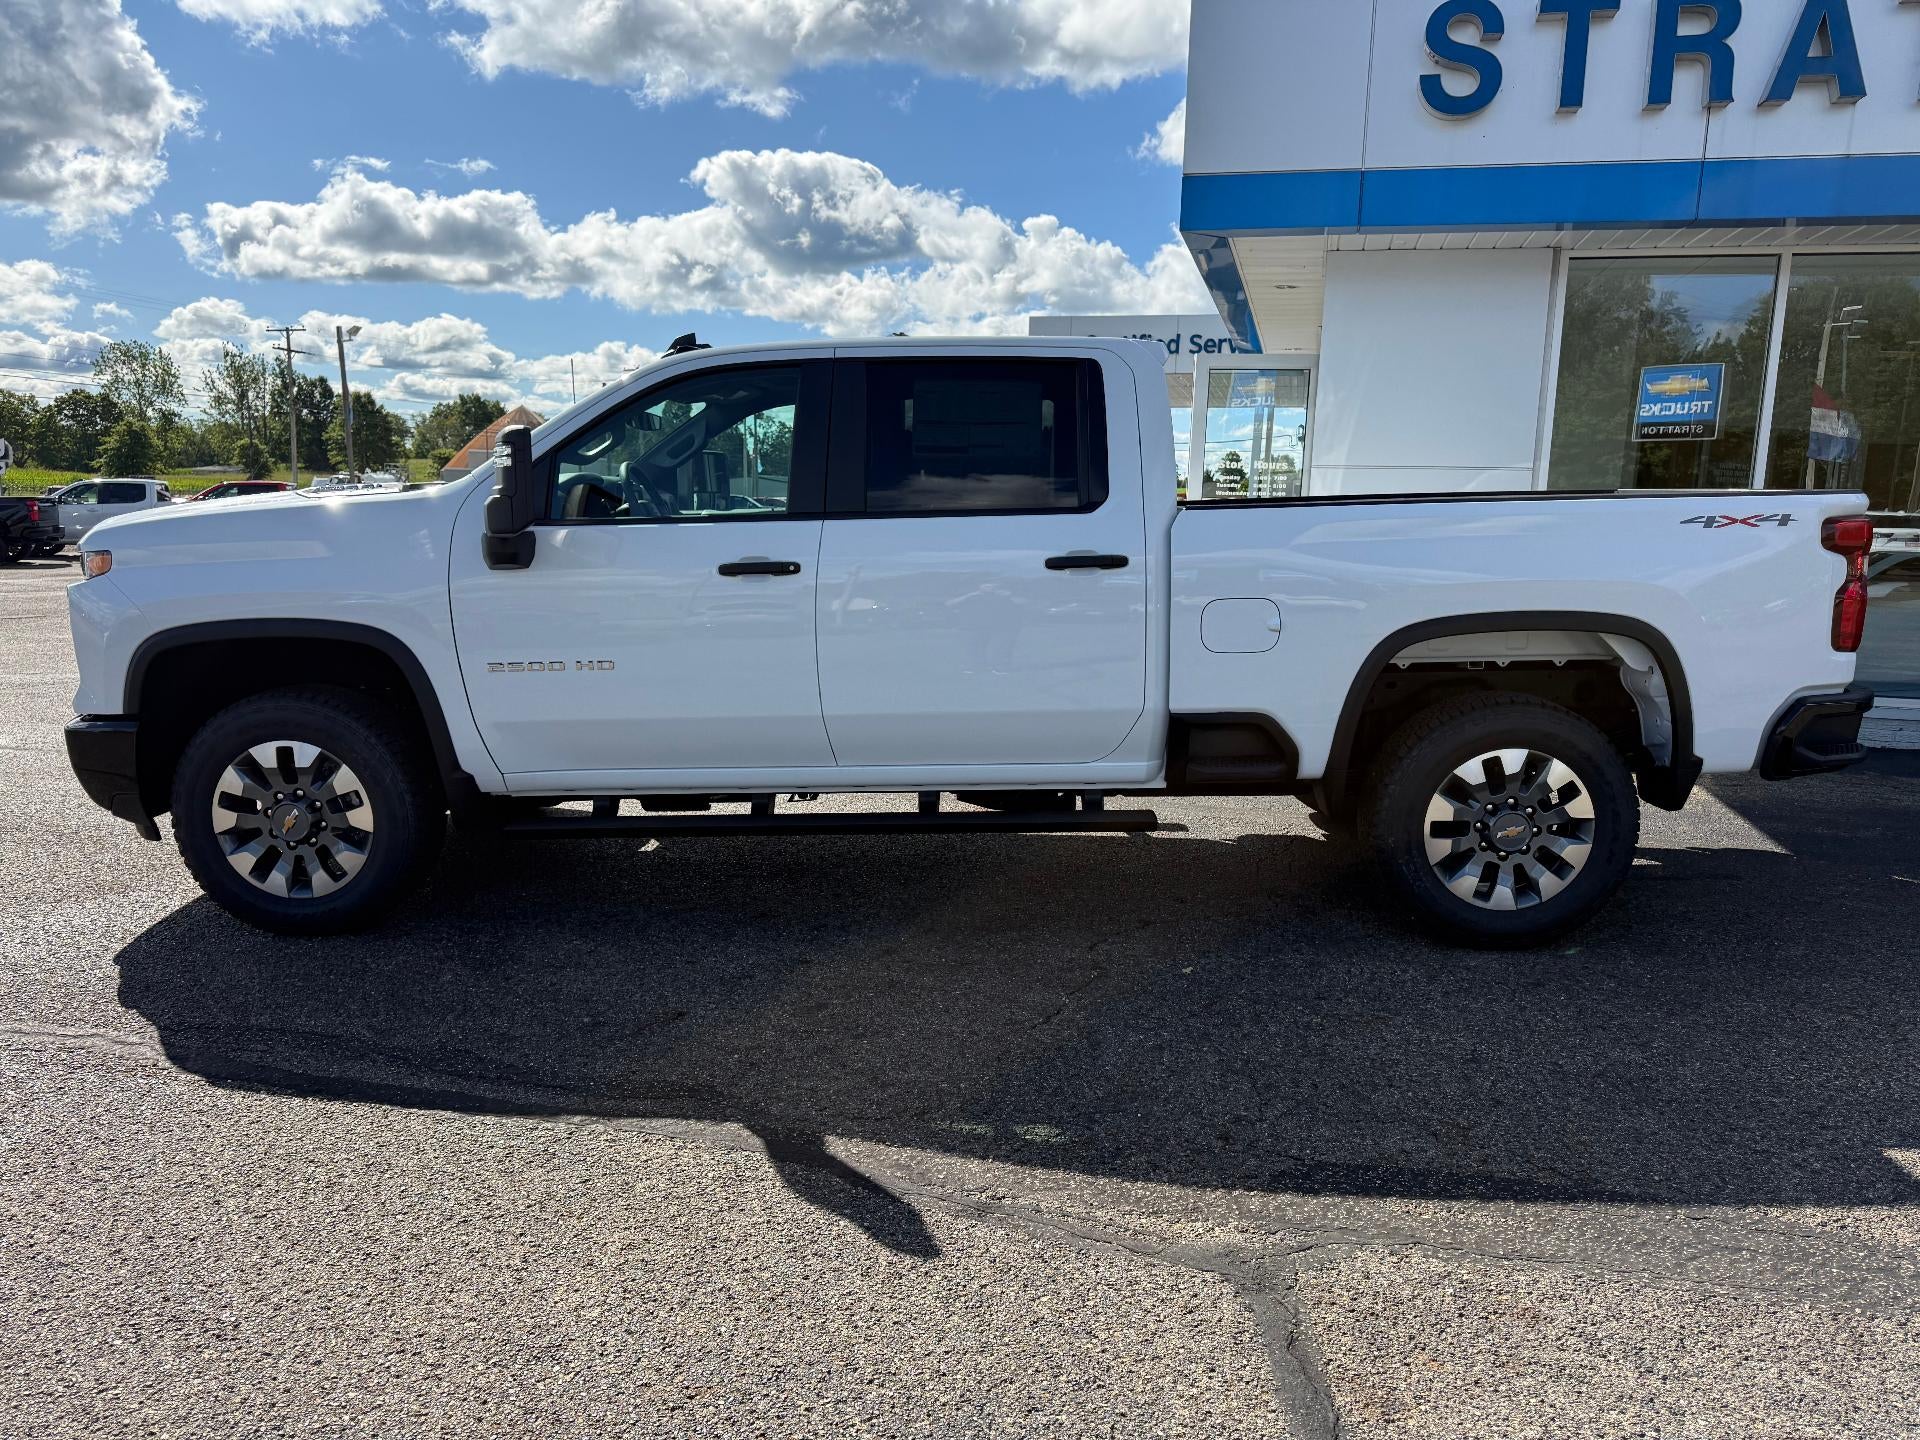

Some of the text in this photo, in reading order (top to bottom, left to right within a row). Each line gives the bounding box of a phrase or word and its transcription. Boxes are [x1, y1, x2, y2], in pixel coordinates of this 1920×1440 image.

[1419, 0, 1920, 121] STRA
[1253, 460, 1288, 469] Hours
[487, 660, 615, 672] 2500 HD
